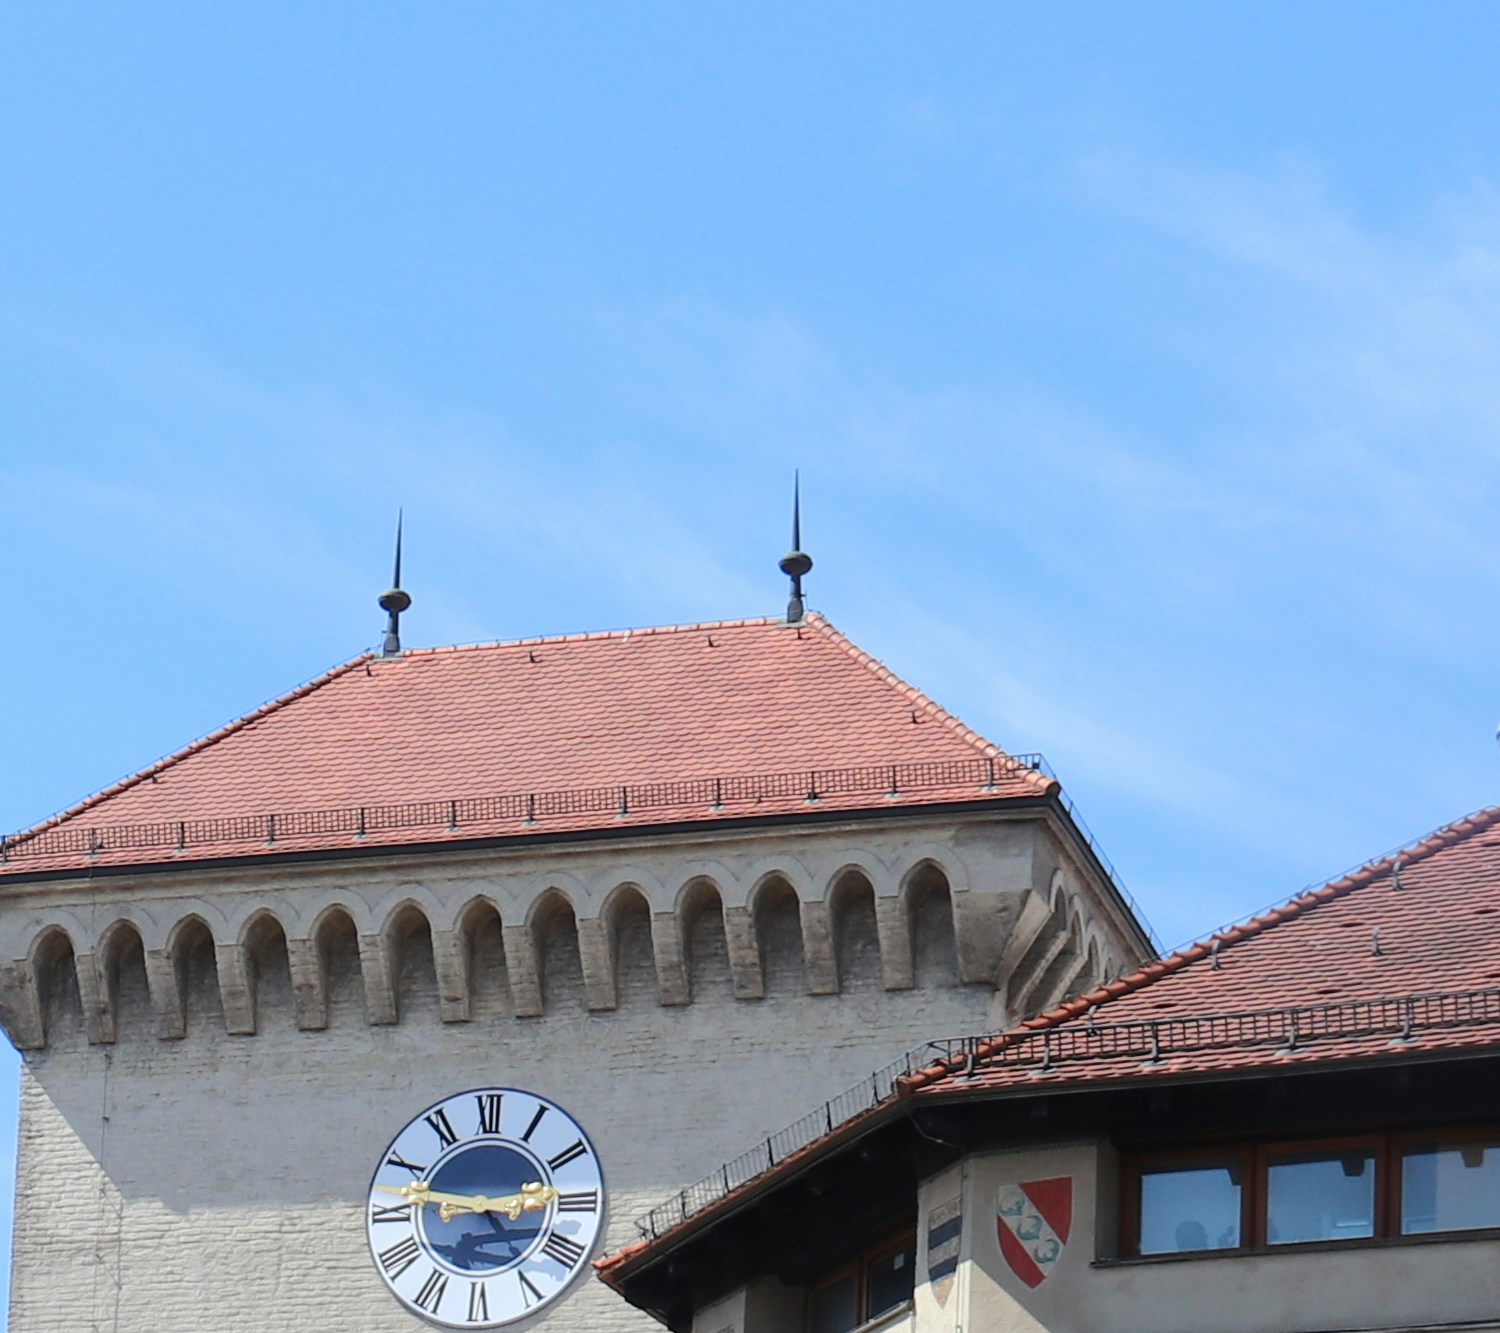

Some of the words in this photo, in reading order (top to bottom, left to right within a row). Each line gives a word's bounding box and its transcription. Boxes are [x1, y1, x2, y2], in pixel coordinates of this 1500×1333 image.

[424, 1107, 459, 1151] XI
[474, 1094, 504, 1135] XII
[520, 1103, 549, 1143] I
[385, 1150, 427, 1181] X
[547, 1138, 588, 1173] II
[556, 1189, 598, 1214] III
[411, 1268, 450, 1315] VII
[466, 1281, 490, 1322] VI
[518, 1270, 546, 1309] V
